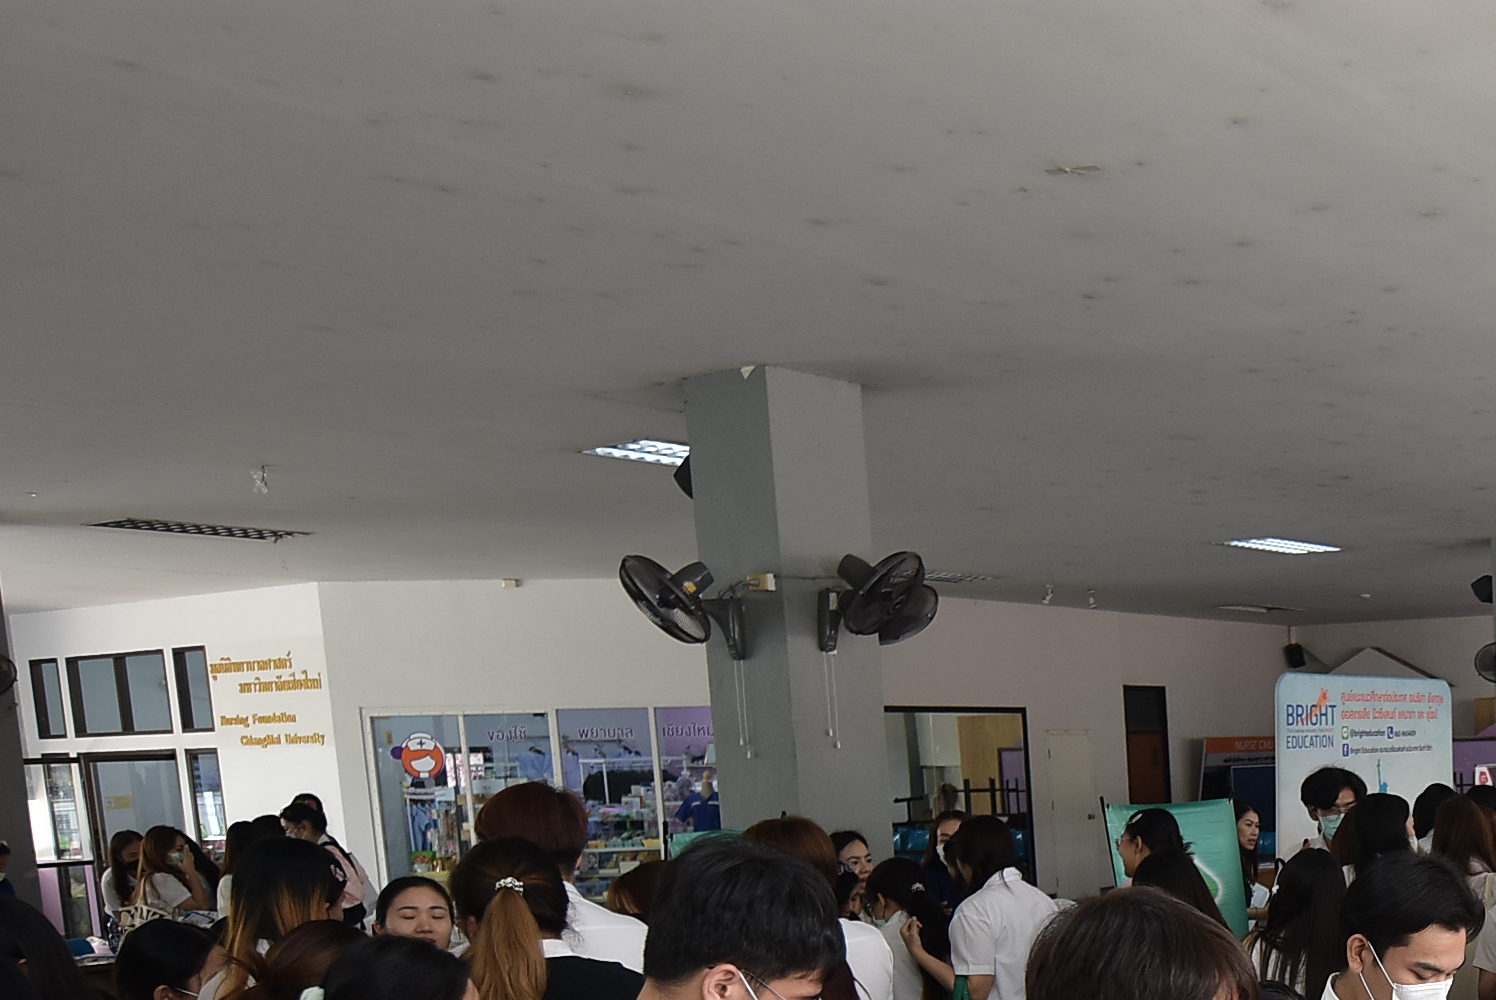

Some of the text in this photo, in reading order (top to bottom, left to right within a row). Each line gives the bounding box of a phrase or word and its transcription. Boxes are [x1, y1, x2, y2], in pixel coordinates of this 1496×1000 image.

[220, 712, 297, 728] Nursing Foundation
[1286, 704, 1336, 727] BRIGHT
[284, 732, 325, 746] University
[486, 725, 528, 742] ของใช้
[577, 725, 634, 740] พยาบาล
[1286, 735, 1334, 750] EDUCATION
